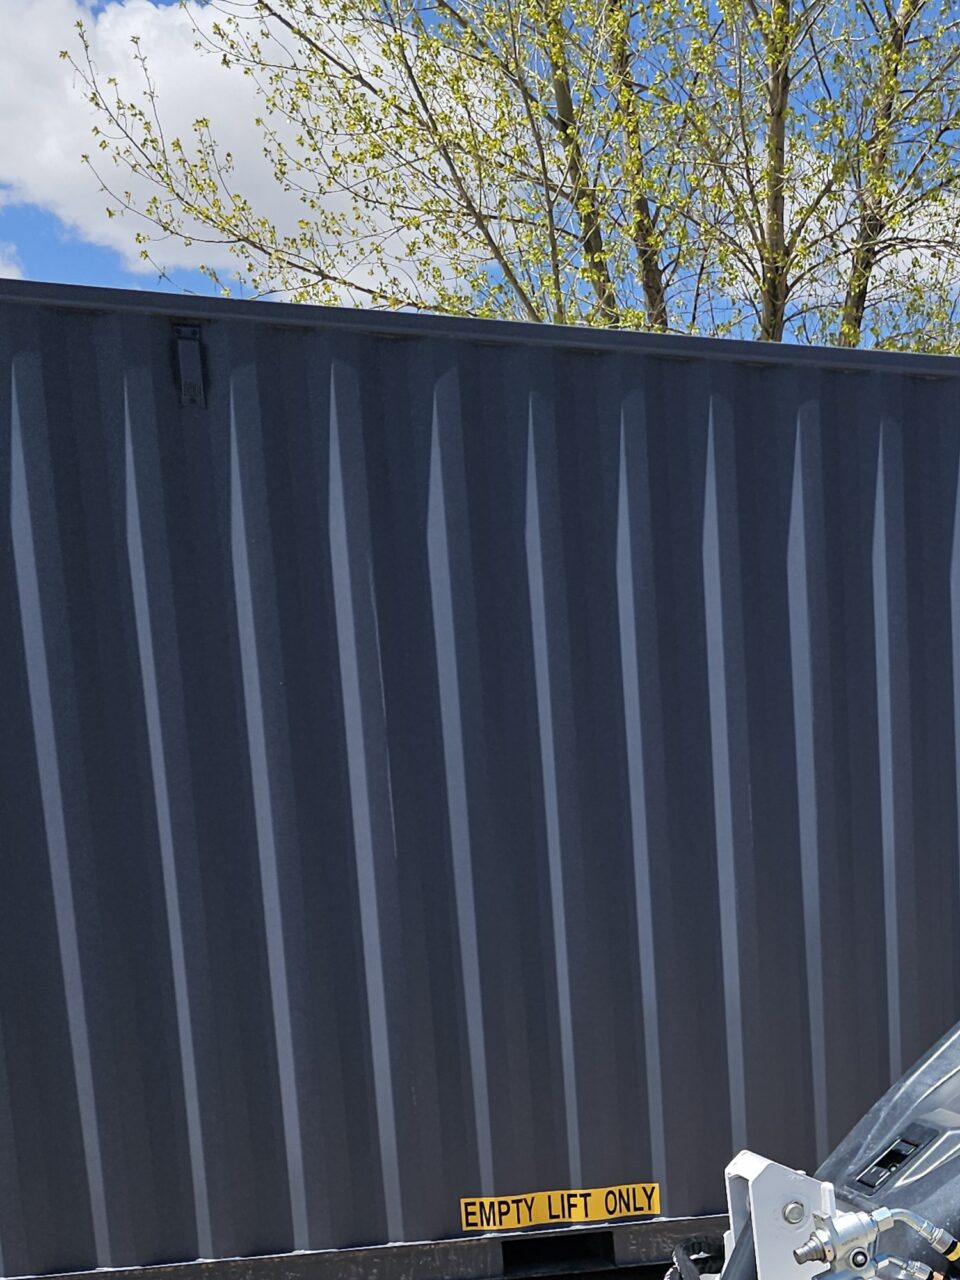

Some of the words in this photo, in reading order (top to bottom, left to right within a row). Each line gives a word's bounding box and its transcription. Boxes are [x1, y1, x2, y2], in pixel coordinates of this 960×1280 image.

[463, 1196, 535, 1227] EMPTY
[547, 1193, 592, 1219] LIFT
[604, 1186, 656, 1215] ONLY
